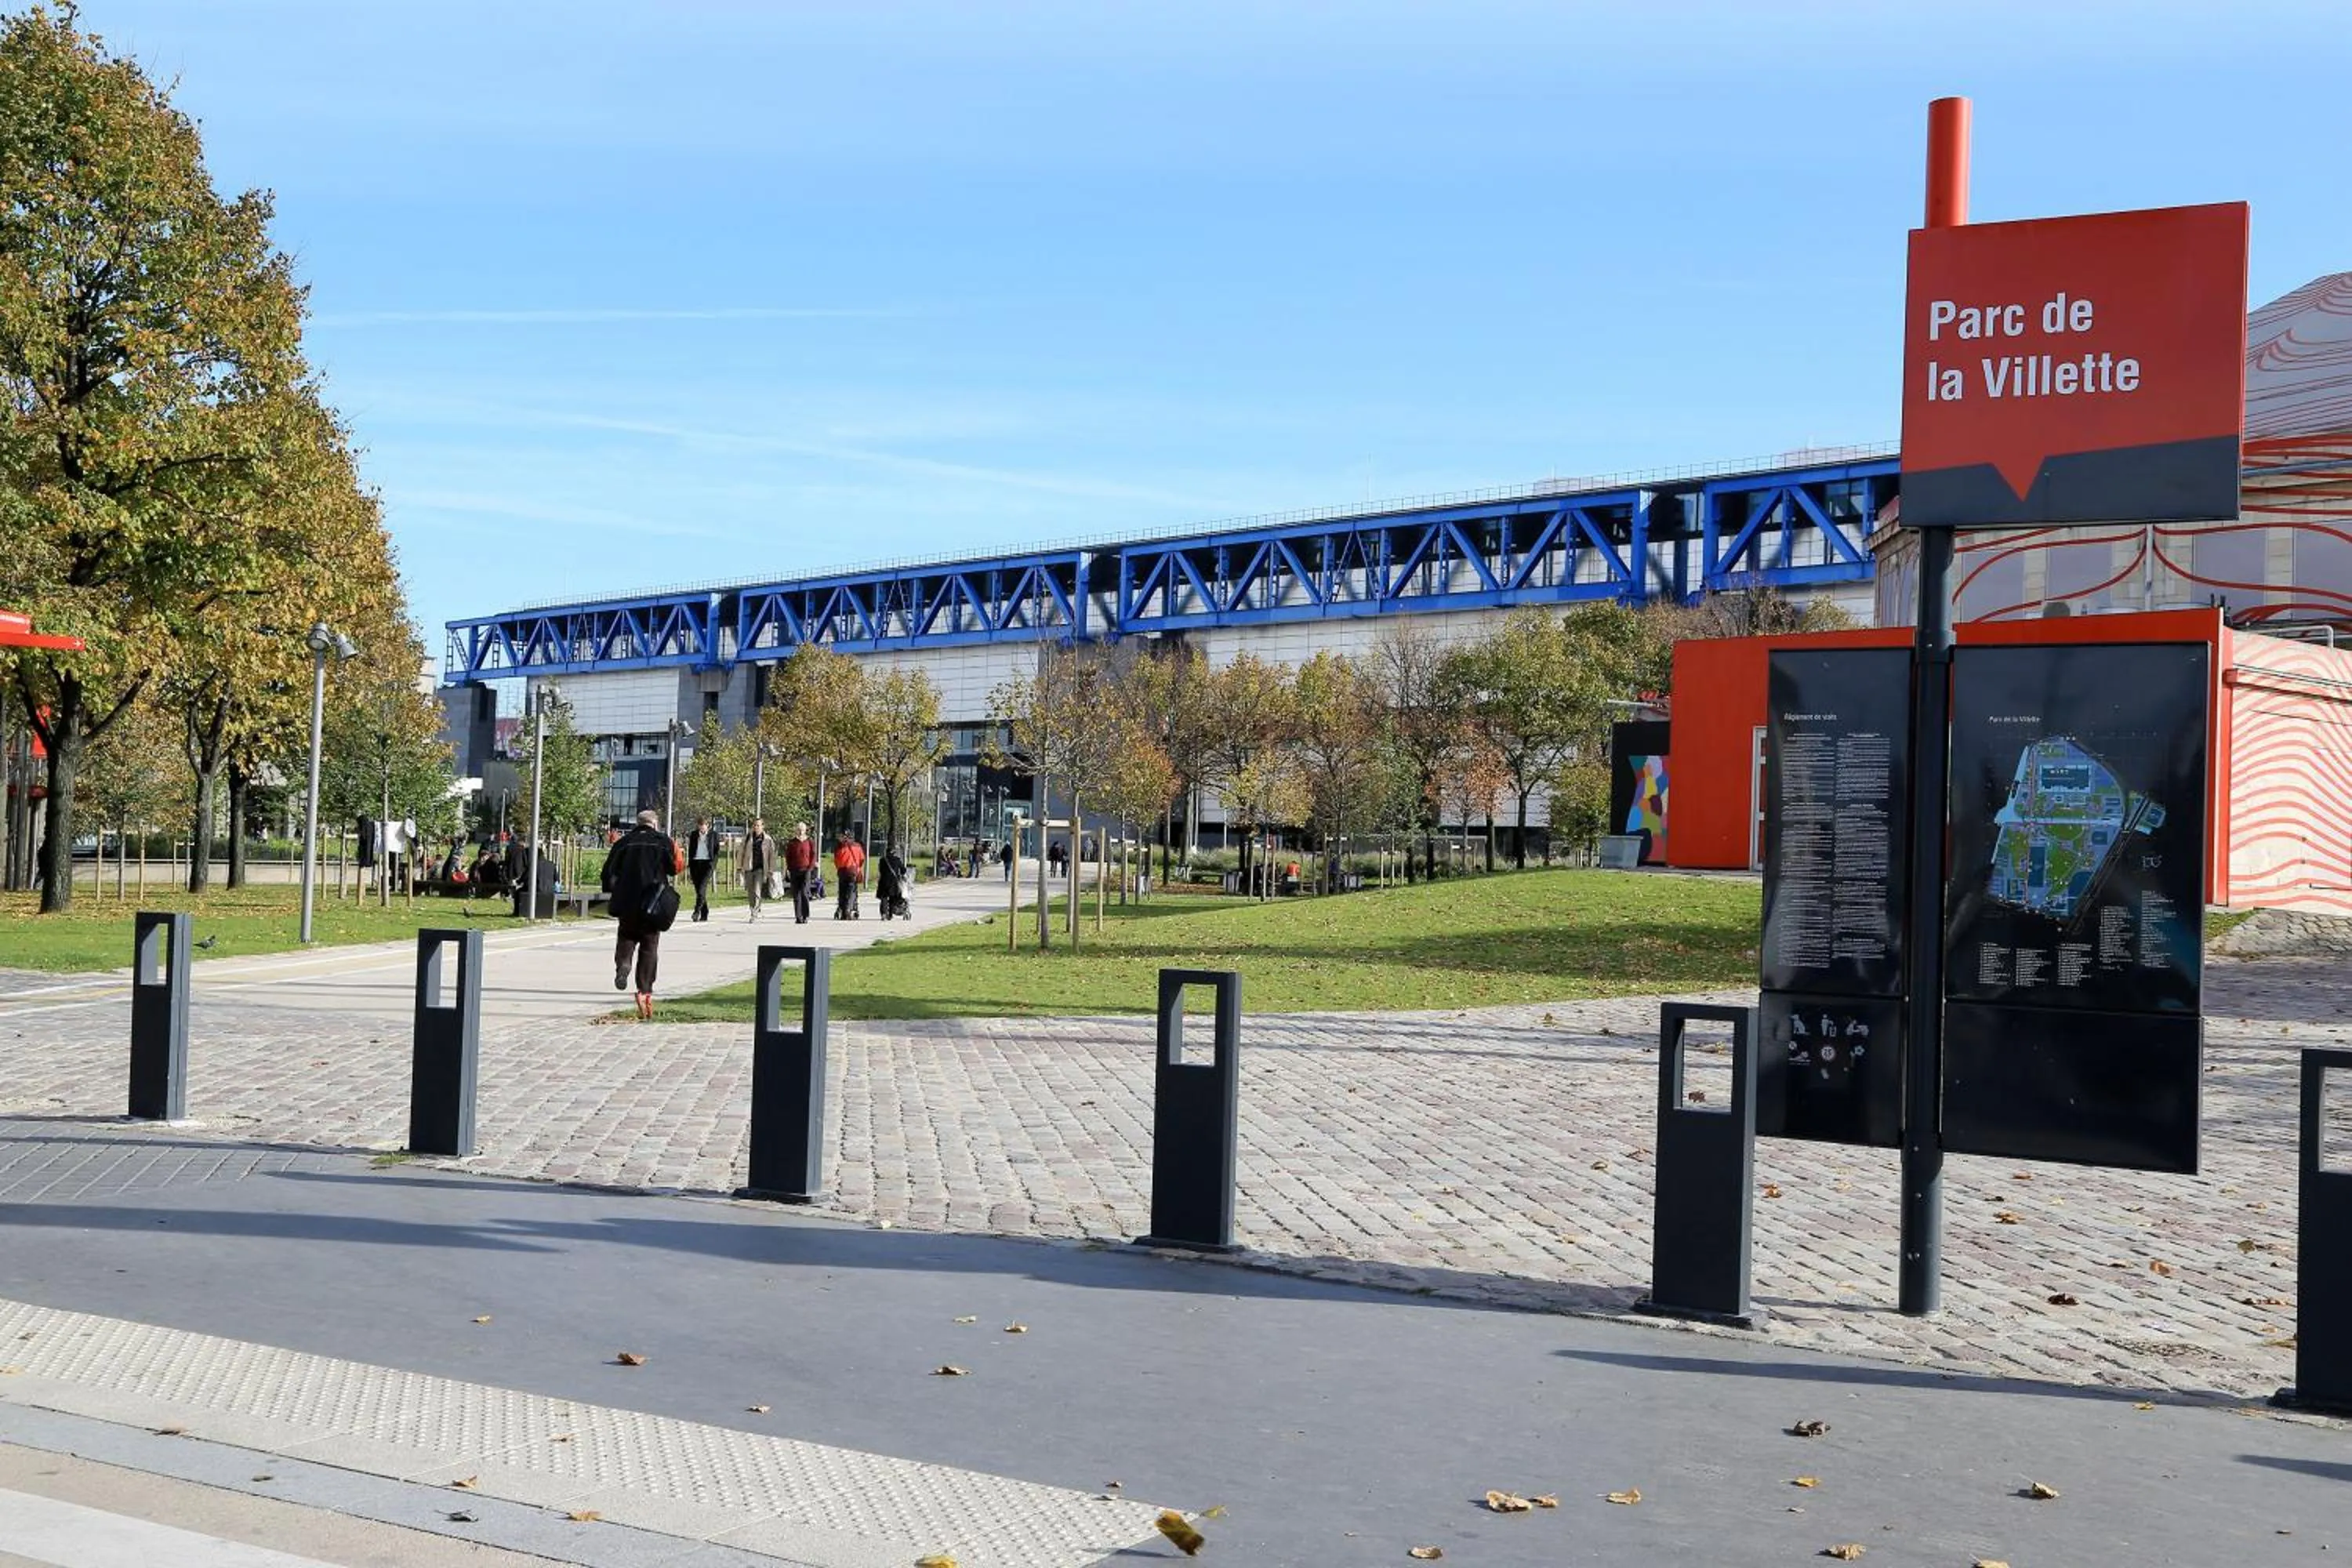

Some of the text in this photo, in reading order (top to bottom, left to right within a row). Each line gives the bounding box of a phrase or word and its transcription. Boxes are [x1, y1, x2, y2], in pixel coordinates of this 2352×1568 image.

[1929, 292, 2093, 341] Parc de
[1928, 352, 2140, 401] la Villette
